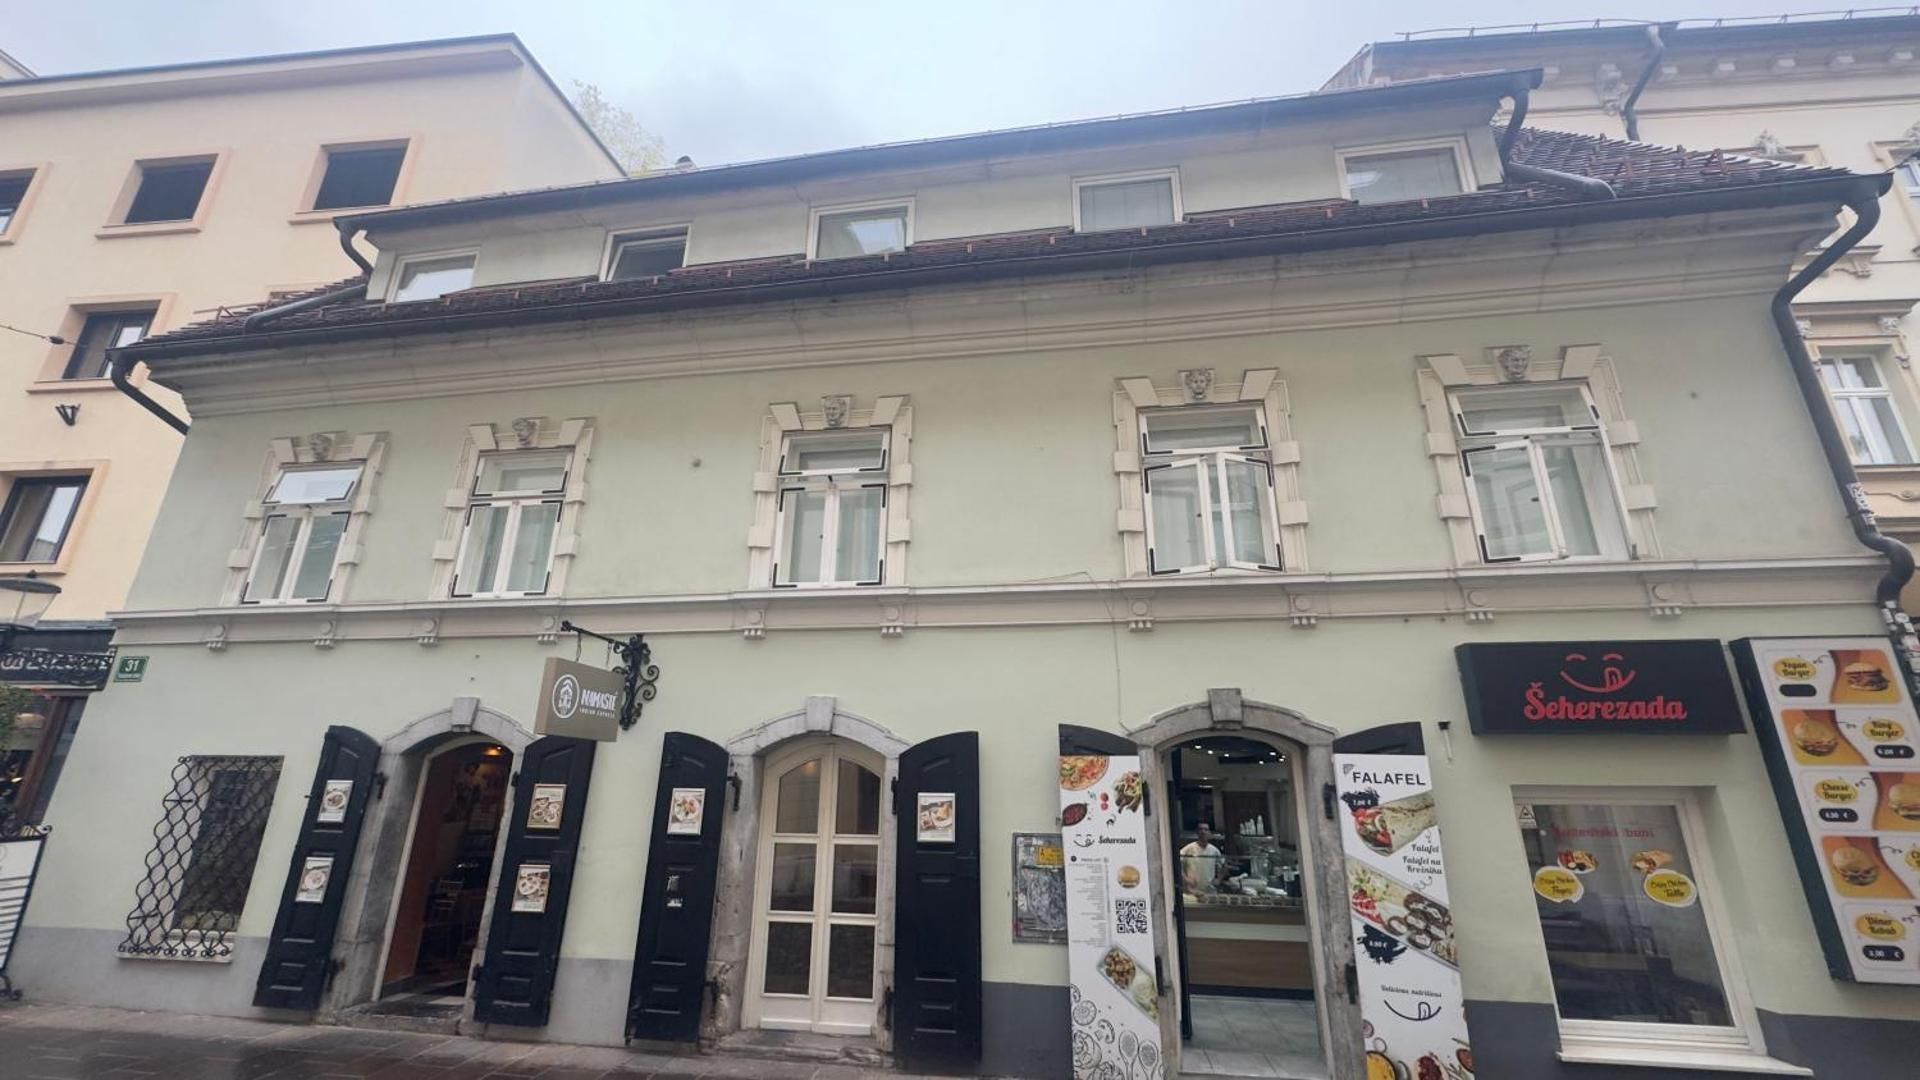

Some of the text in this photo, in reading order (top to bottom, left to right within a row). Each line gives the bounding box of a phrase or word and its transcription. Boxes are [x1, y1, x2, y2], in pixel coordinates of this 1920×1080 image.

[125, 660, 140, 672] 31
[1524, 682, 1688, 720] Šeherezada
[1352, 771, 1426, 786] FALAFEL
[1412, 844, 1440, 854] Falafel
[1403, 855, 1430, 866] Falafel
